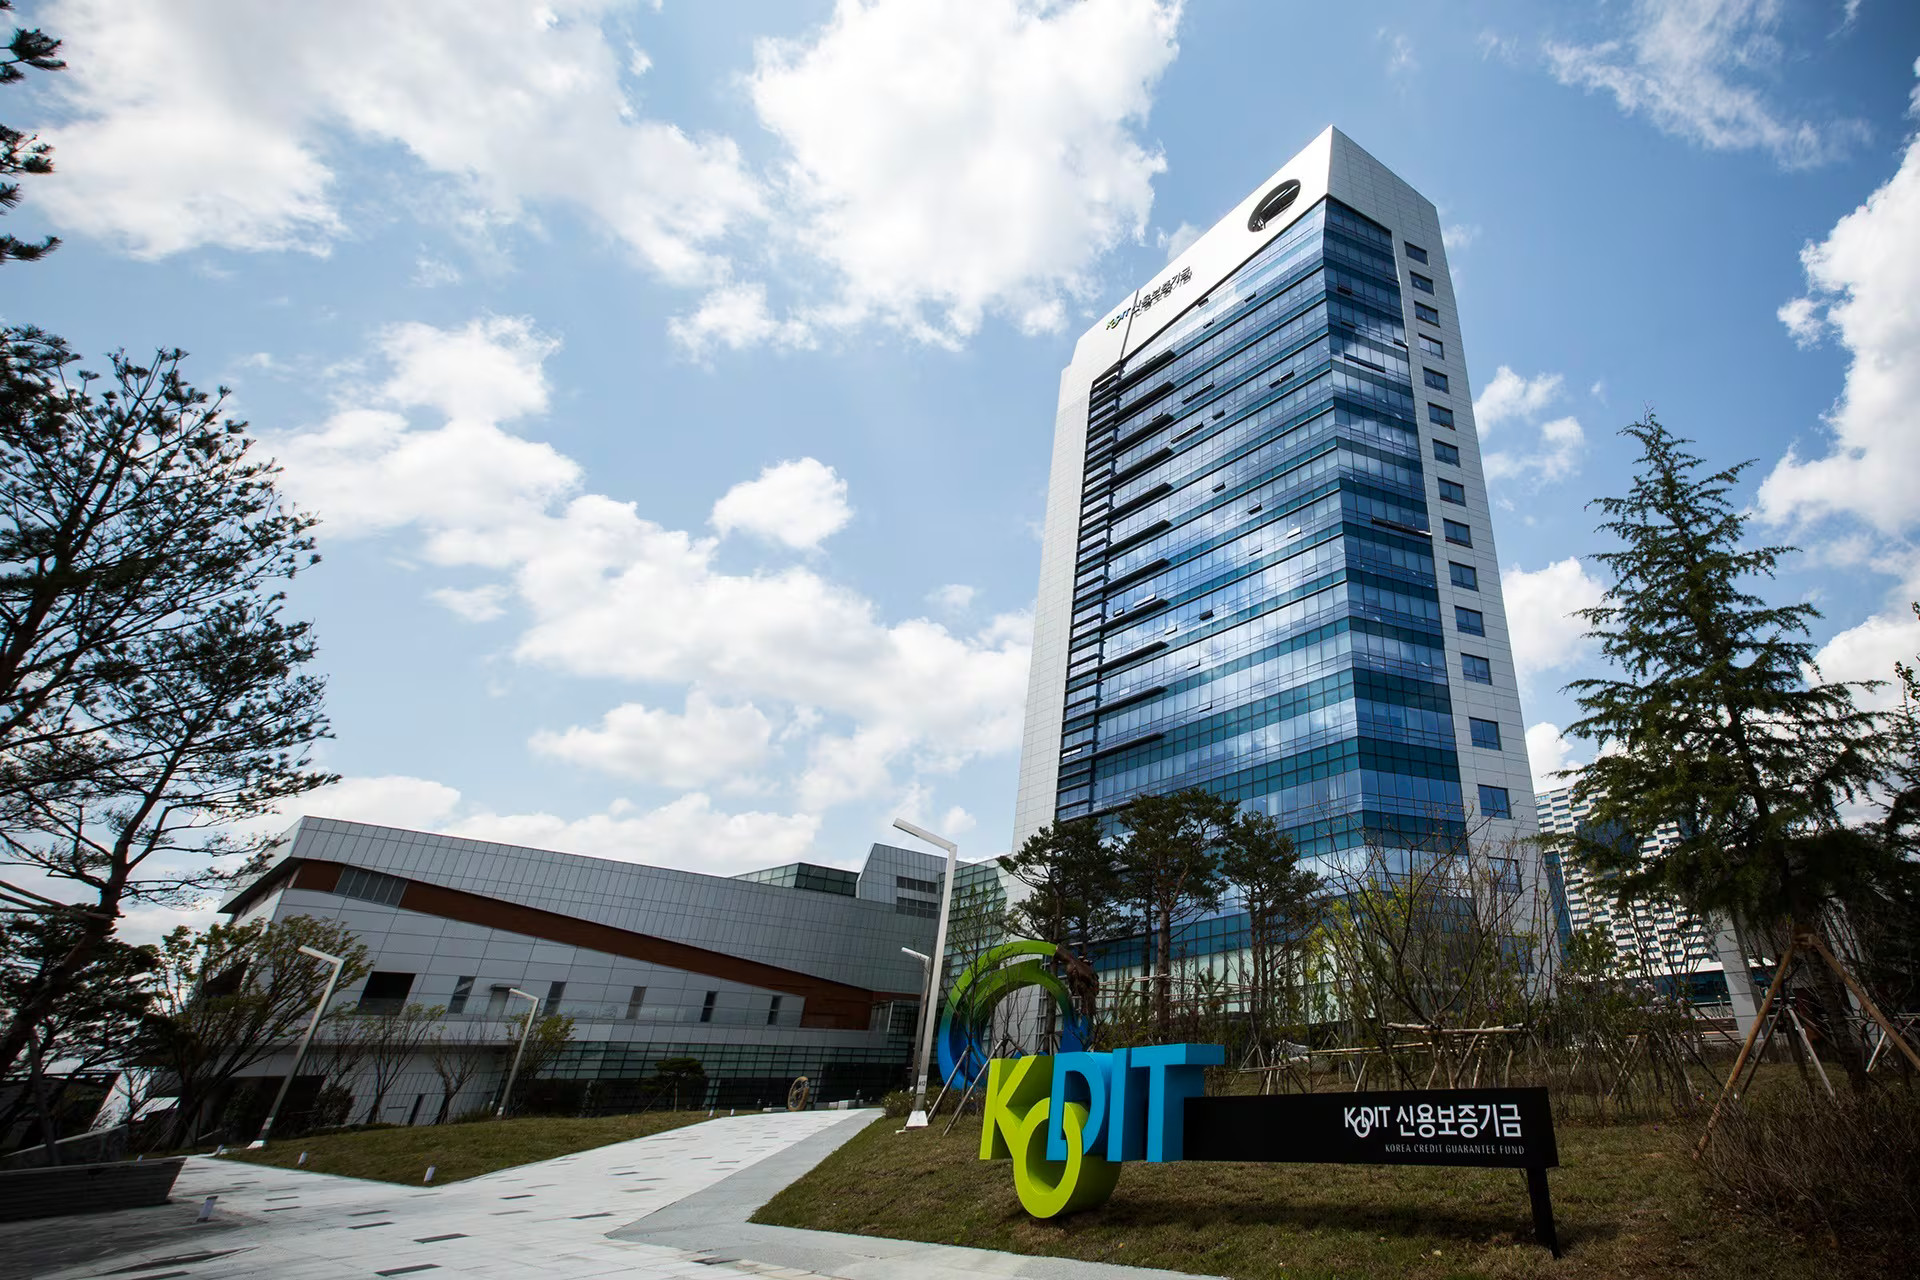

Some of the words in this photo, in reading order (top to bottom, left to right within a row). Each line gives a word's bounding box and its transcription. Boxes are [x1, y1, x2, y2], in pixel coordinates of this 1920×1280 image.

[979, 1043, 1222, 1218] KODIT
[1344, 1106, 1391, 1138] KODIT
[1396, 1103, 1522, 1138] 신용보증기금
[1385, 1144, 1411, 1153] KOREA
[1413, 1144, 1443, 1154] CREDIT
[1445, 1144, 1496, 1154] GUARANTEE
[1499, 1144, 1525, 1155] FUND
